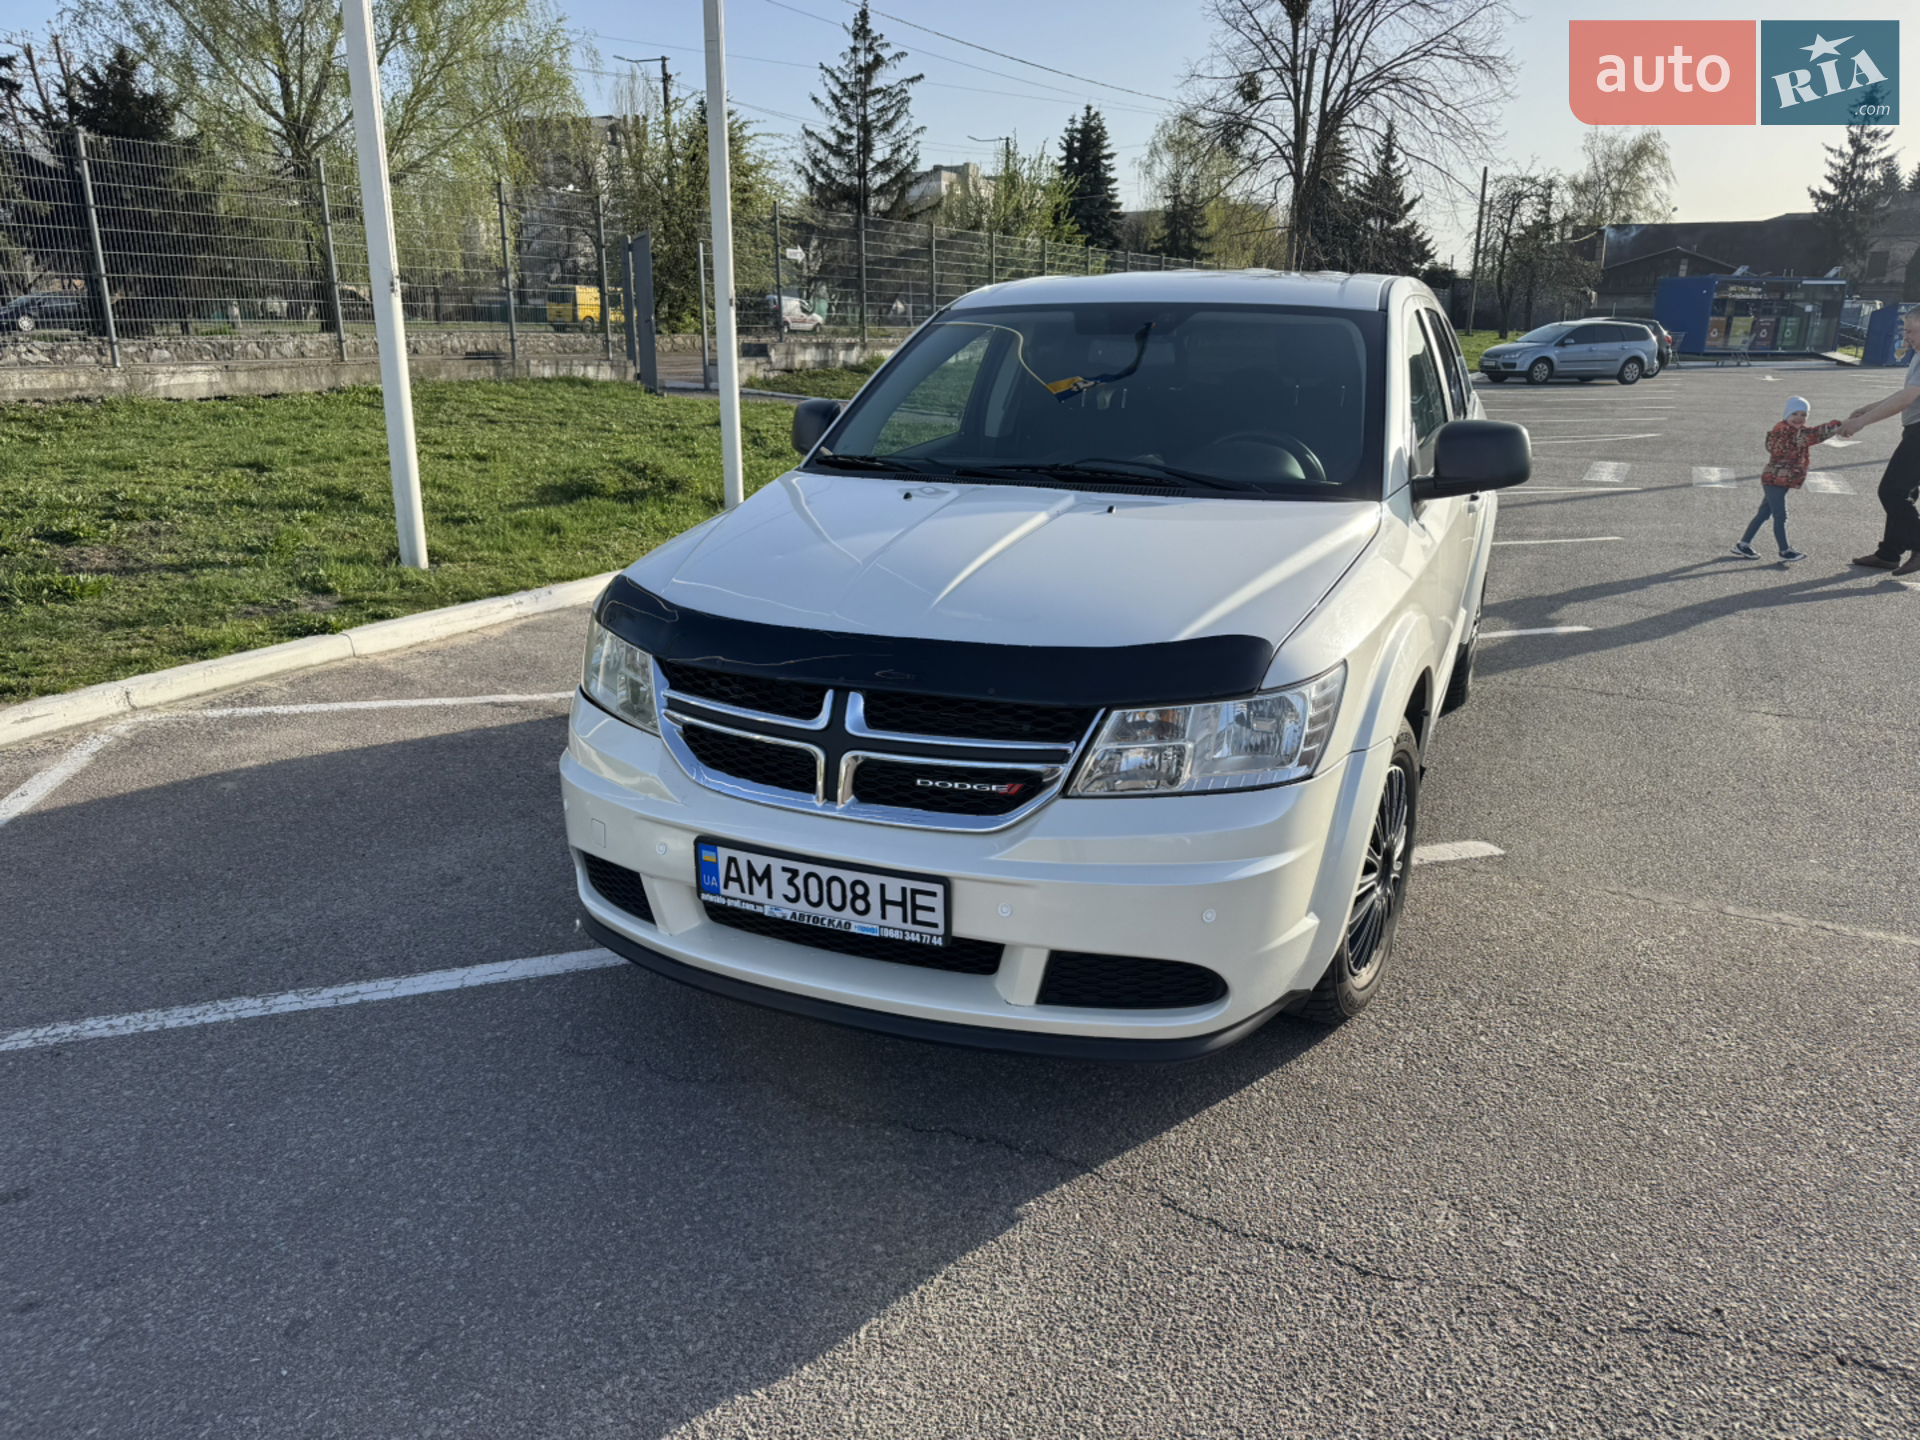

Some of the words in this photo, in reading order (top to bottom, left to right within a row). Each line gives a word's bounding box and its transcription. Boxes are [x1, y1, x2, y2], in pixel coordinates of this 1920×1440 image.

[916, 779, 1009, 794] DODGE
[703, 874, 718, 888] UA
[723, 855, 773, 899] AM
[781, 866, 872, 917] 3008
[880, 883, 940, 930] HE
[904, 931, 921, 943] 344
[921, 934, 931, 944] 77
[931, 936, 943, 946] 44
